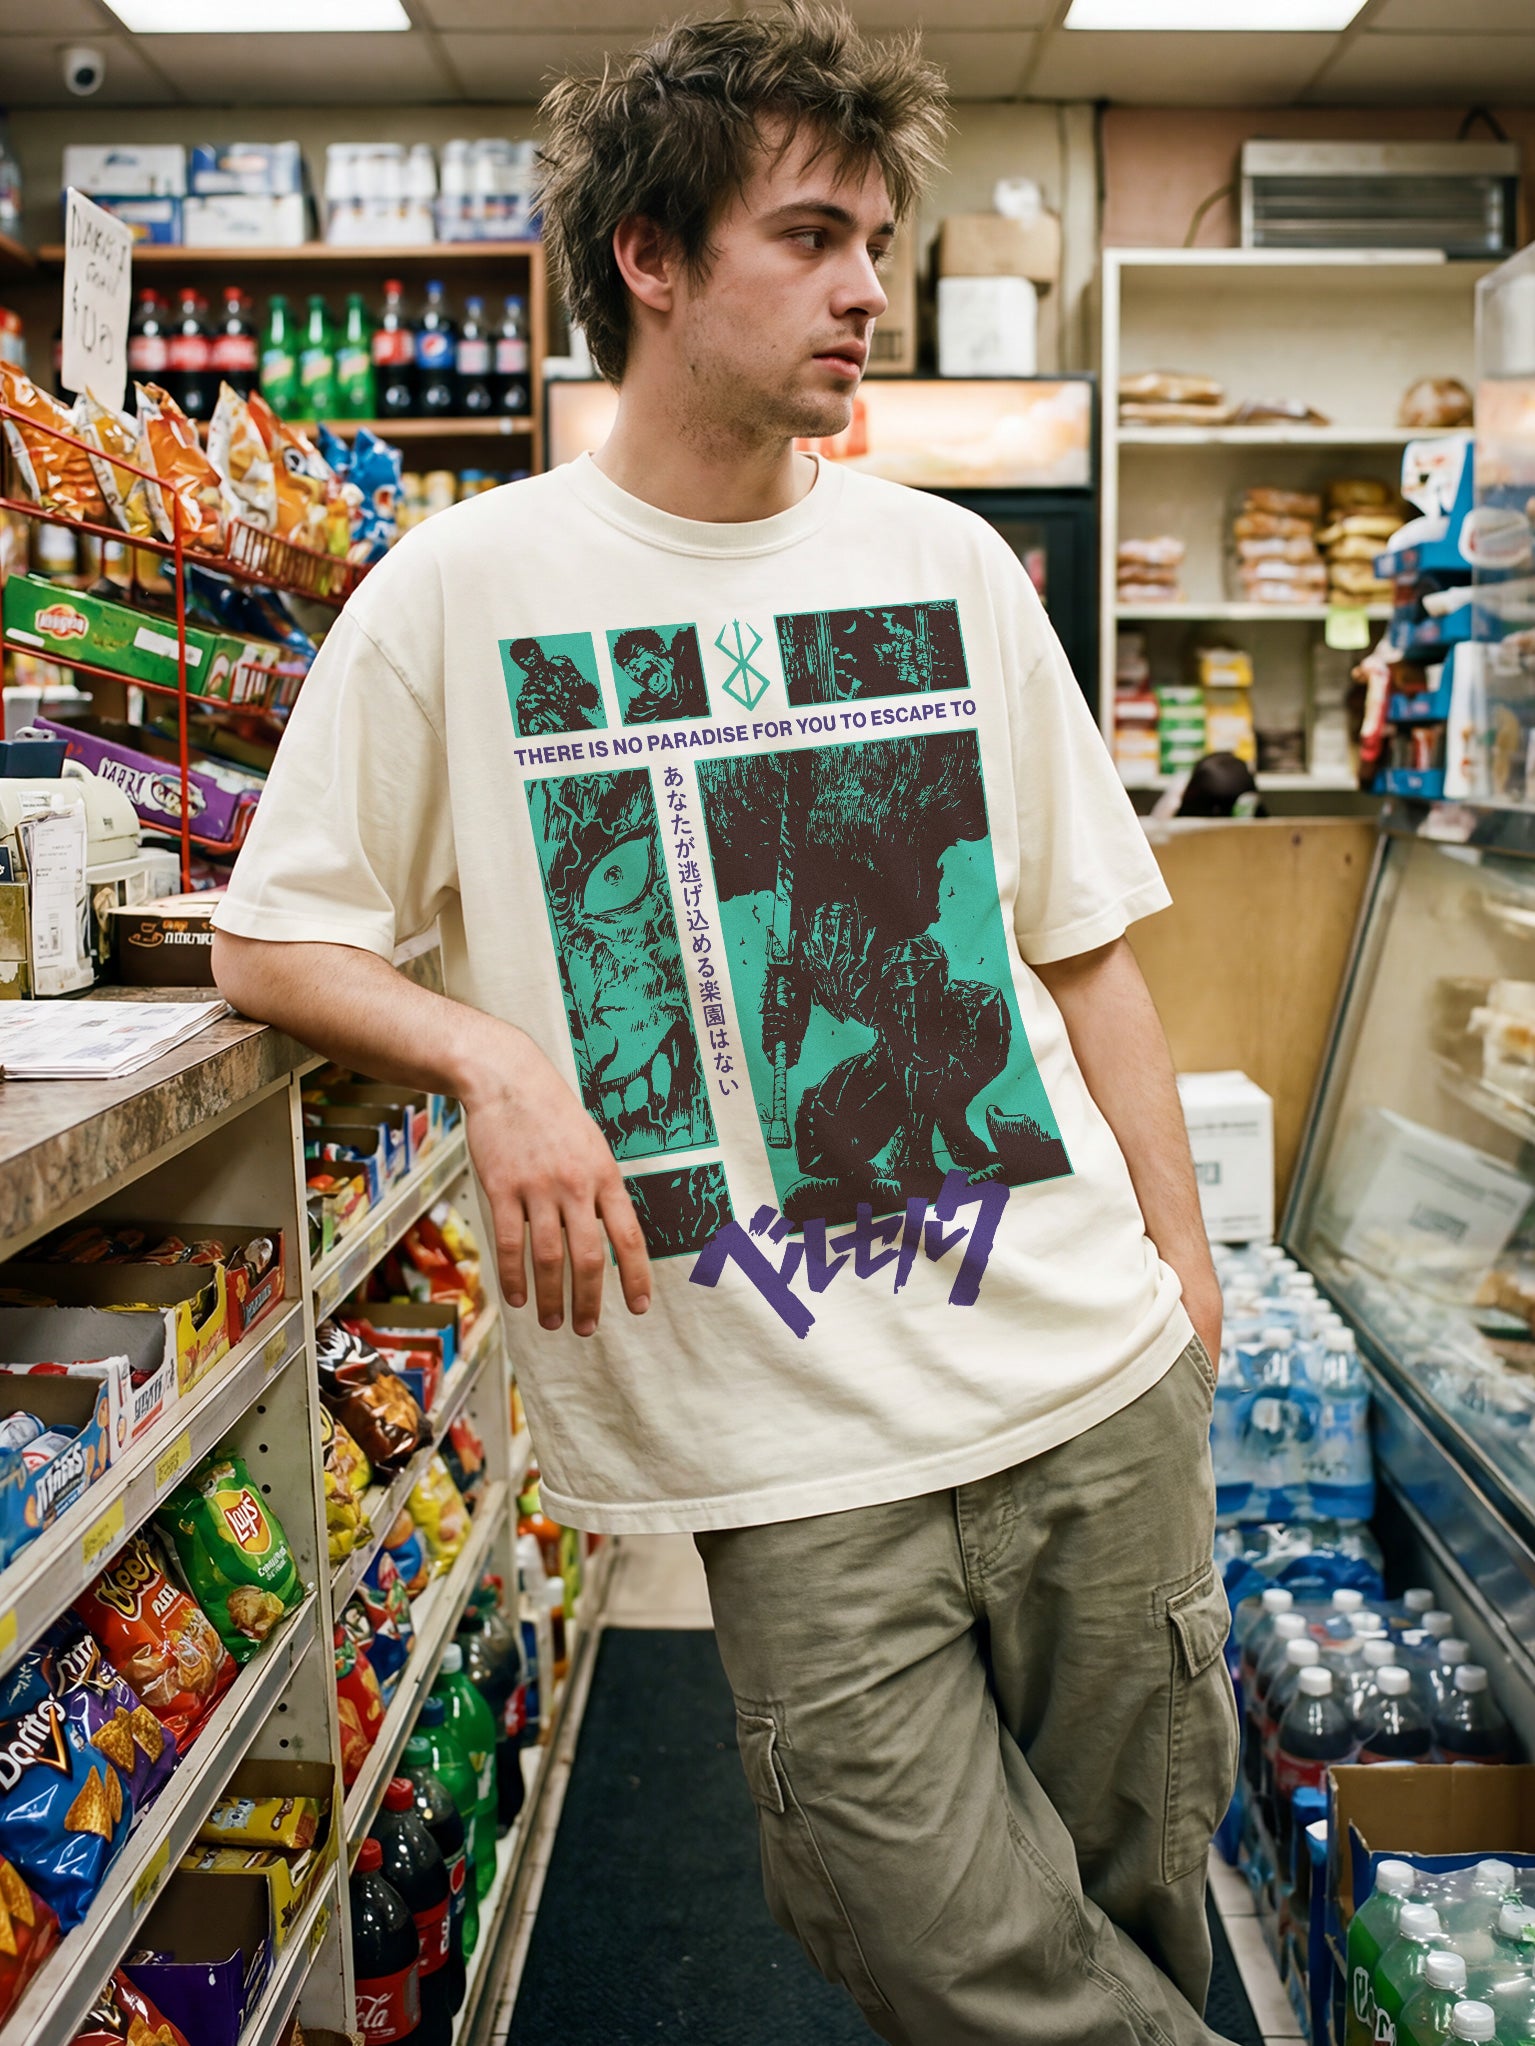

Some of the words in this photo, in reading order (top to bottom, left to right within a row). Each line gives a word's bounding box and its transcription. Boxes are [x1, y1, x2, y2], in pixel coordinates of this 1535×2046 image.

[513, 743, 585, 766] THERE
[589, 741, 609, 759] IS
[612, 737, 643, 756] NO
[647, 725, 749, 752] PARADISE
[752, 720, 793, 739] FOR
[796, 715, 837, 735] YOU
[839, 712, 867, 730] TO
[870, 703, 947, 727] ESCAPE
[950, 699, 977, 718] TO
[664, 766, 739, 1096] あなたが逃げ込める楽園はない
[688, 1169, 1011, 1340] ベルセルク
